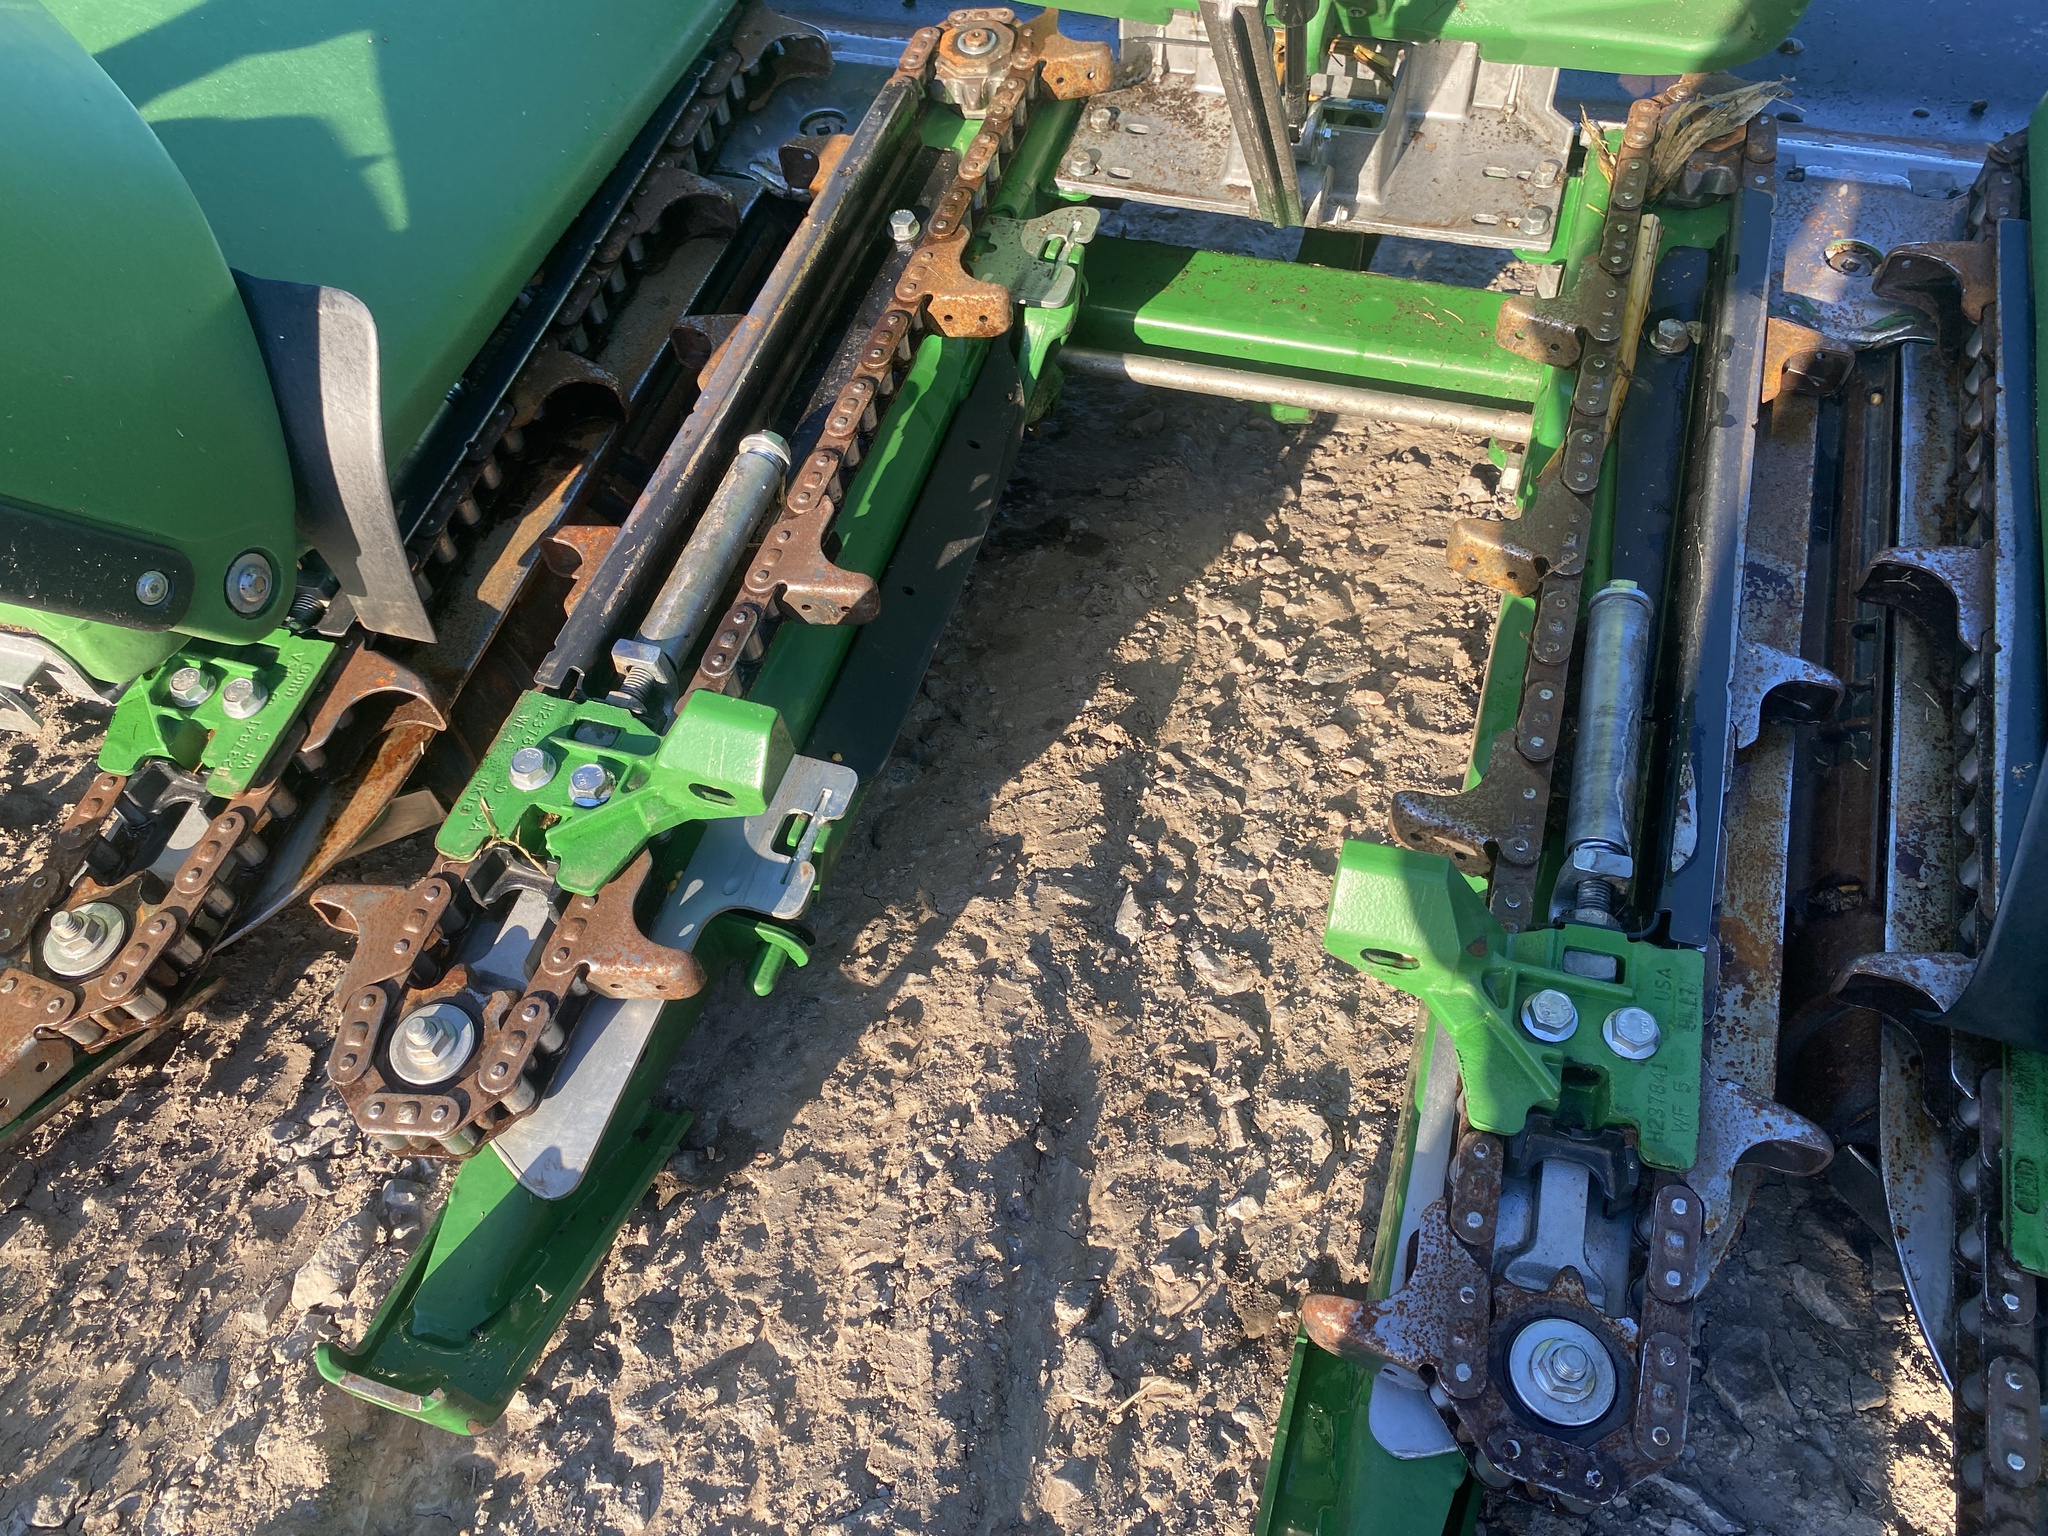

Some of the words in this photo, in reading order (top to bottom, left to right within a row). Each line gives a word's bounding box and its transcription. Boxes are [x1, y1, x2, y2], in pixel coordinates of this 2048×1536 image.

[519, 701, 556, 750] H2378
[1654, 967, 1672, 1003] USA
[1646, 1061, 1668, 1144] H237841
[1673, 1080, 1691, 1094] 5
[1670, 1103, 1691, 1133] WF
